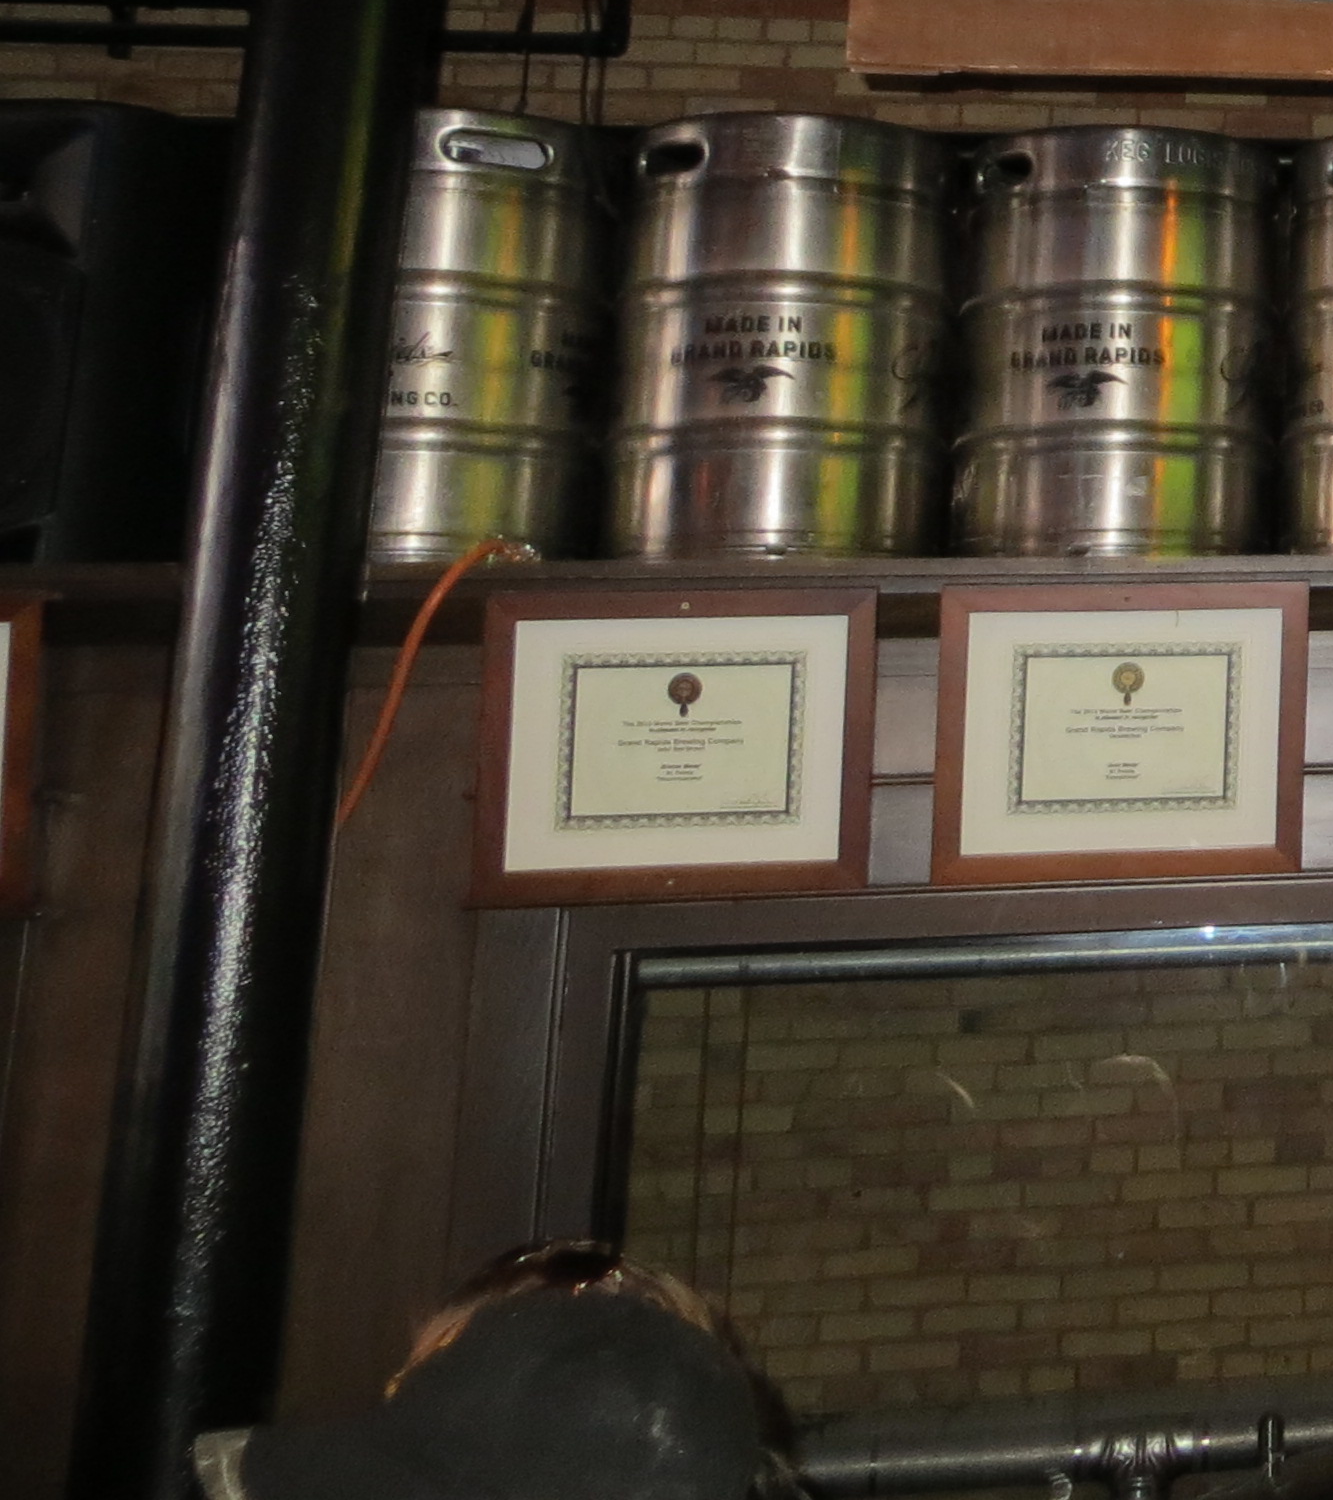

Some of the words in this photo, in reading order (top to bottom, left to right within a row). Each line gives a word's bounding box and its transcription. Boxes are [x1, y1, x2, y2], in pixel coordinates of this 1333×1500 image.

[706, 315, 770, 334] MADE
[778, 315, 802, 333] IN
[1042, 322, 1102, 342] MADE
[1110, 323, 1132, 340] IN
